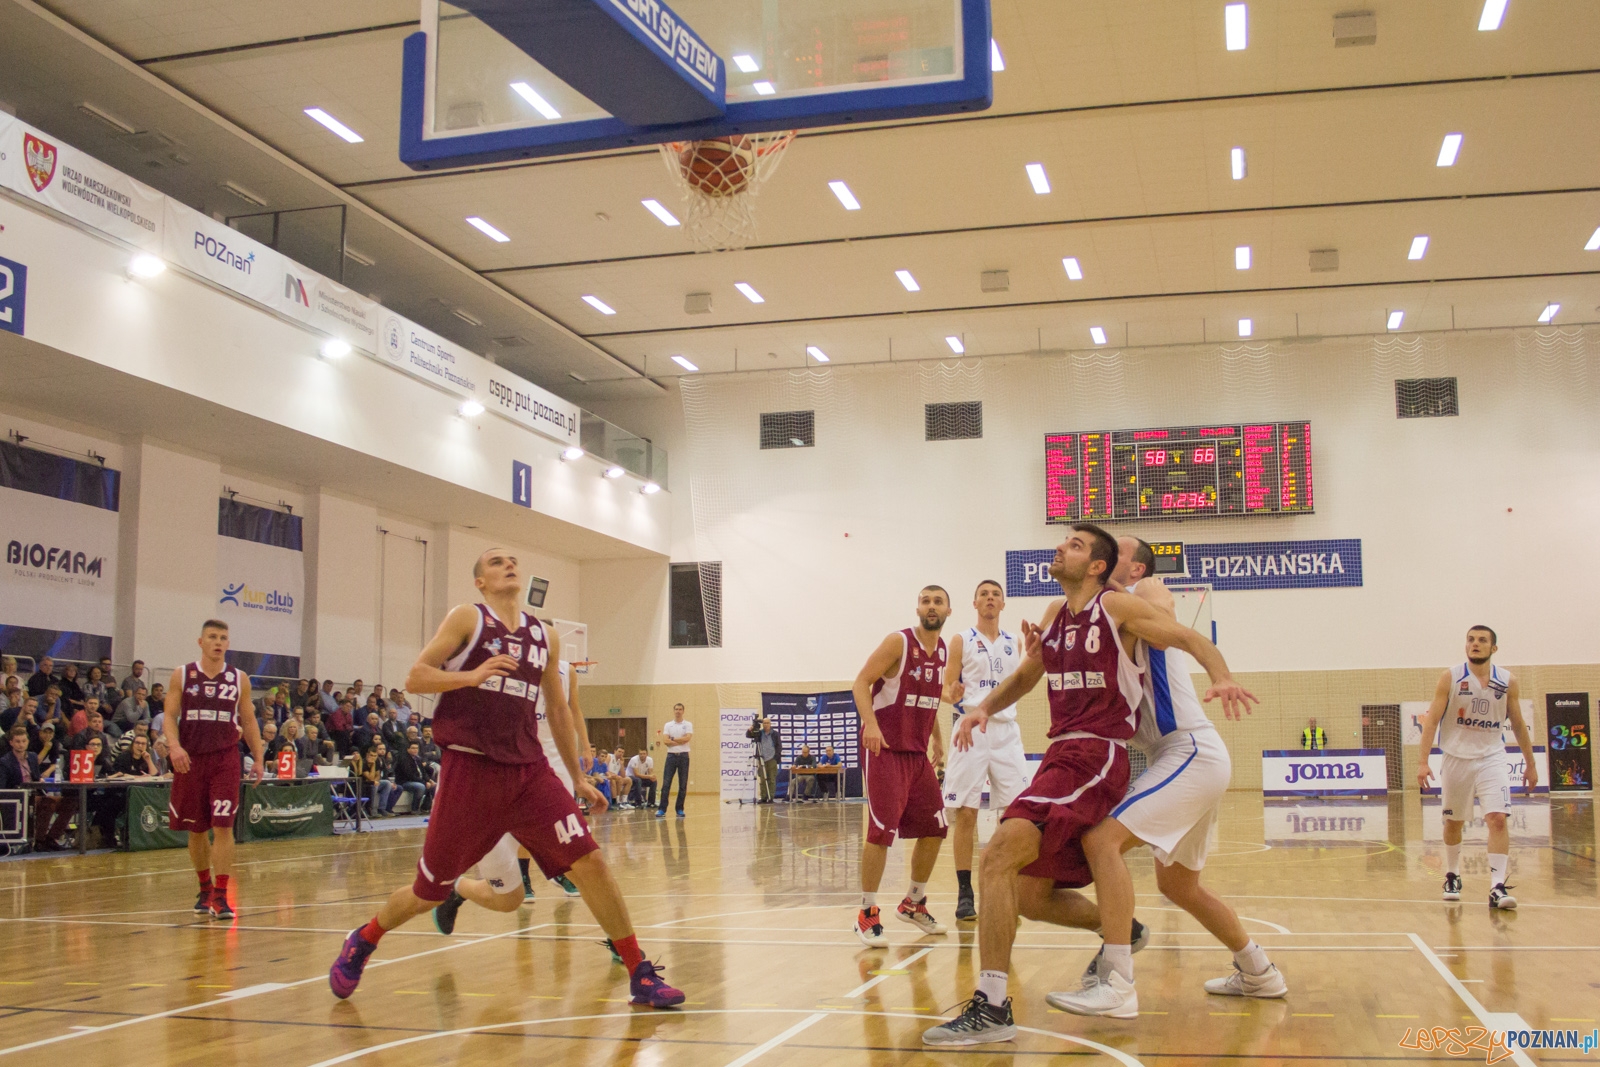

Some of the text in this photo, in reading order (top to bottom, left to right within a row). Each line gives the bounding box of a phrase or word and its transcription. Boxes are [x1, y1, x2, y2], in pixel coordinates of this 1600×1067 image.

[84, 176, 132, 208] MARSZAŁKOWSKI
[62, 179, 156, 233] WOJEWÓDZTWA WIELKOPOLSKIEGO
[411, 331, 456, 364] Centrum Sportu
[410, 350, 443, 377] Politechniki
[489, 379, 577, 436] cspp.put.poznan.pl
[1145, 450, 1167, 466] 58
[1194, 448, 1215, 464] 66
[518, 468, 527, 502] 1
[7, 540, 102, 578] BIOFARM
[1200, 550, 1345, 577] POZNAŃSKA
[1085, 625, 1100, 654] 8
[527, 644, 548, 672] 44
[218, 683, 237, 701] 22
[1471, 697, 1490, 715] 10
[1550, 724, 1588, 750] 35
[280, 754, 291, 772] 5
[213, 799, 232, 817] 22
[553, 813, 584, 844] 44
